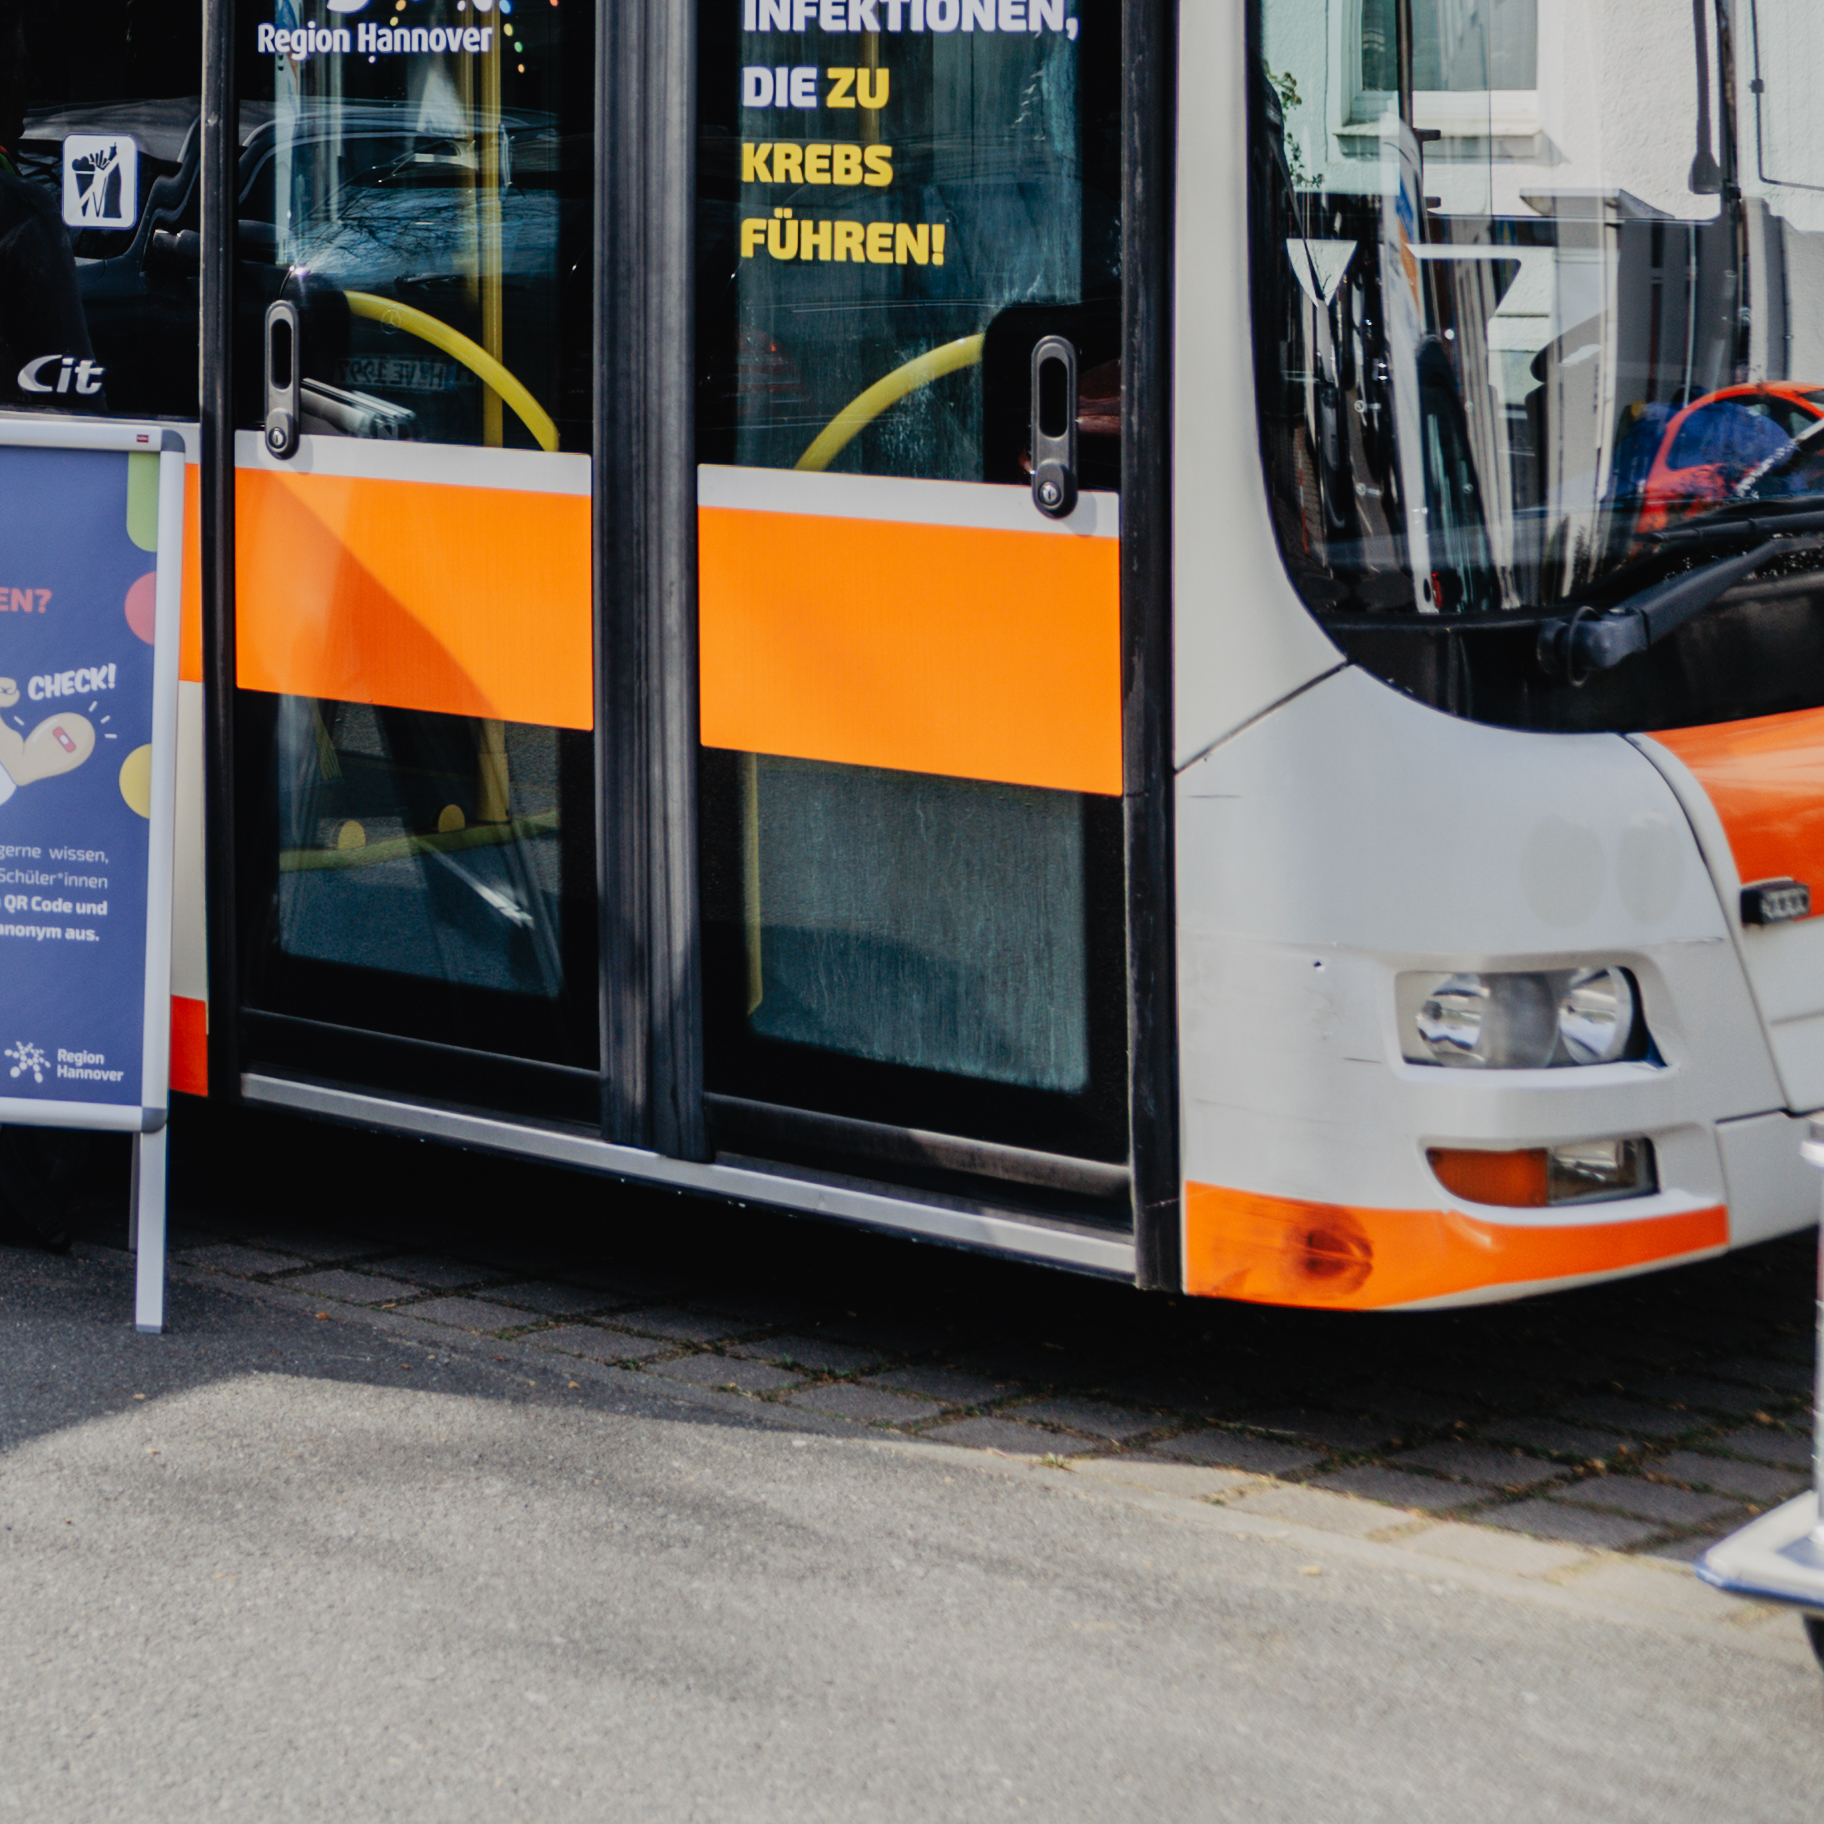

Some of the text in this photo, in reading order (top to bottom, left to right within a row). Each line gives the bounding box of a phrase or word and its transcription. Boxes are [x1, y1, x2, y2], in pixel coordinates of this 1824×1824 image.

[257, 21, 493, 61] Region Hannover
[742, 65, 890, 109] DIE ZU
[740, 142, 893, 187] KREBS
[740, 206, 945, 265] FÜHREN!
[26, 663, 118, 701] CHECK!
[49, 846, 109, 865] wissen,
[4, 894, 28, 914] QR
[31, 896, 73, 914] Code
[75, 900, 108, 916] und
[64, 927, 100, 943] aus.
[56, 1048, 105, 1067] Region
[56, 1063, 125, 1083] Hannover
